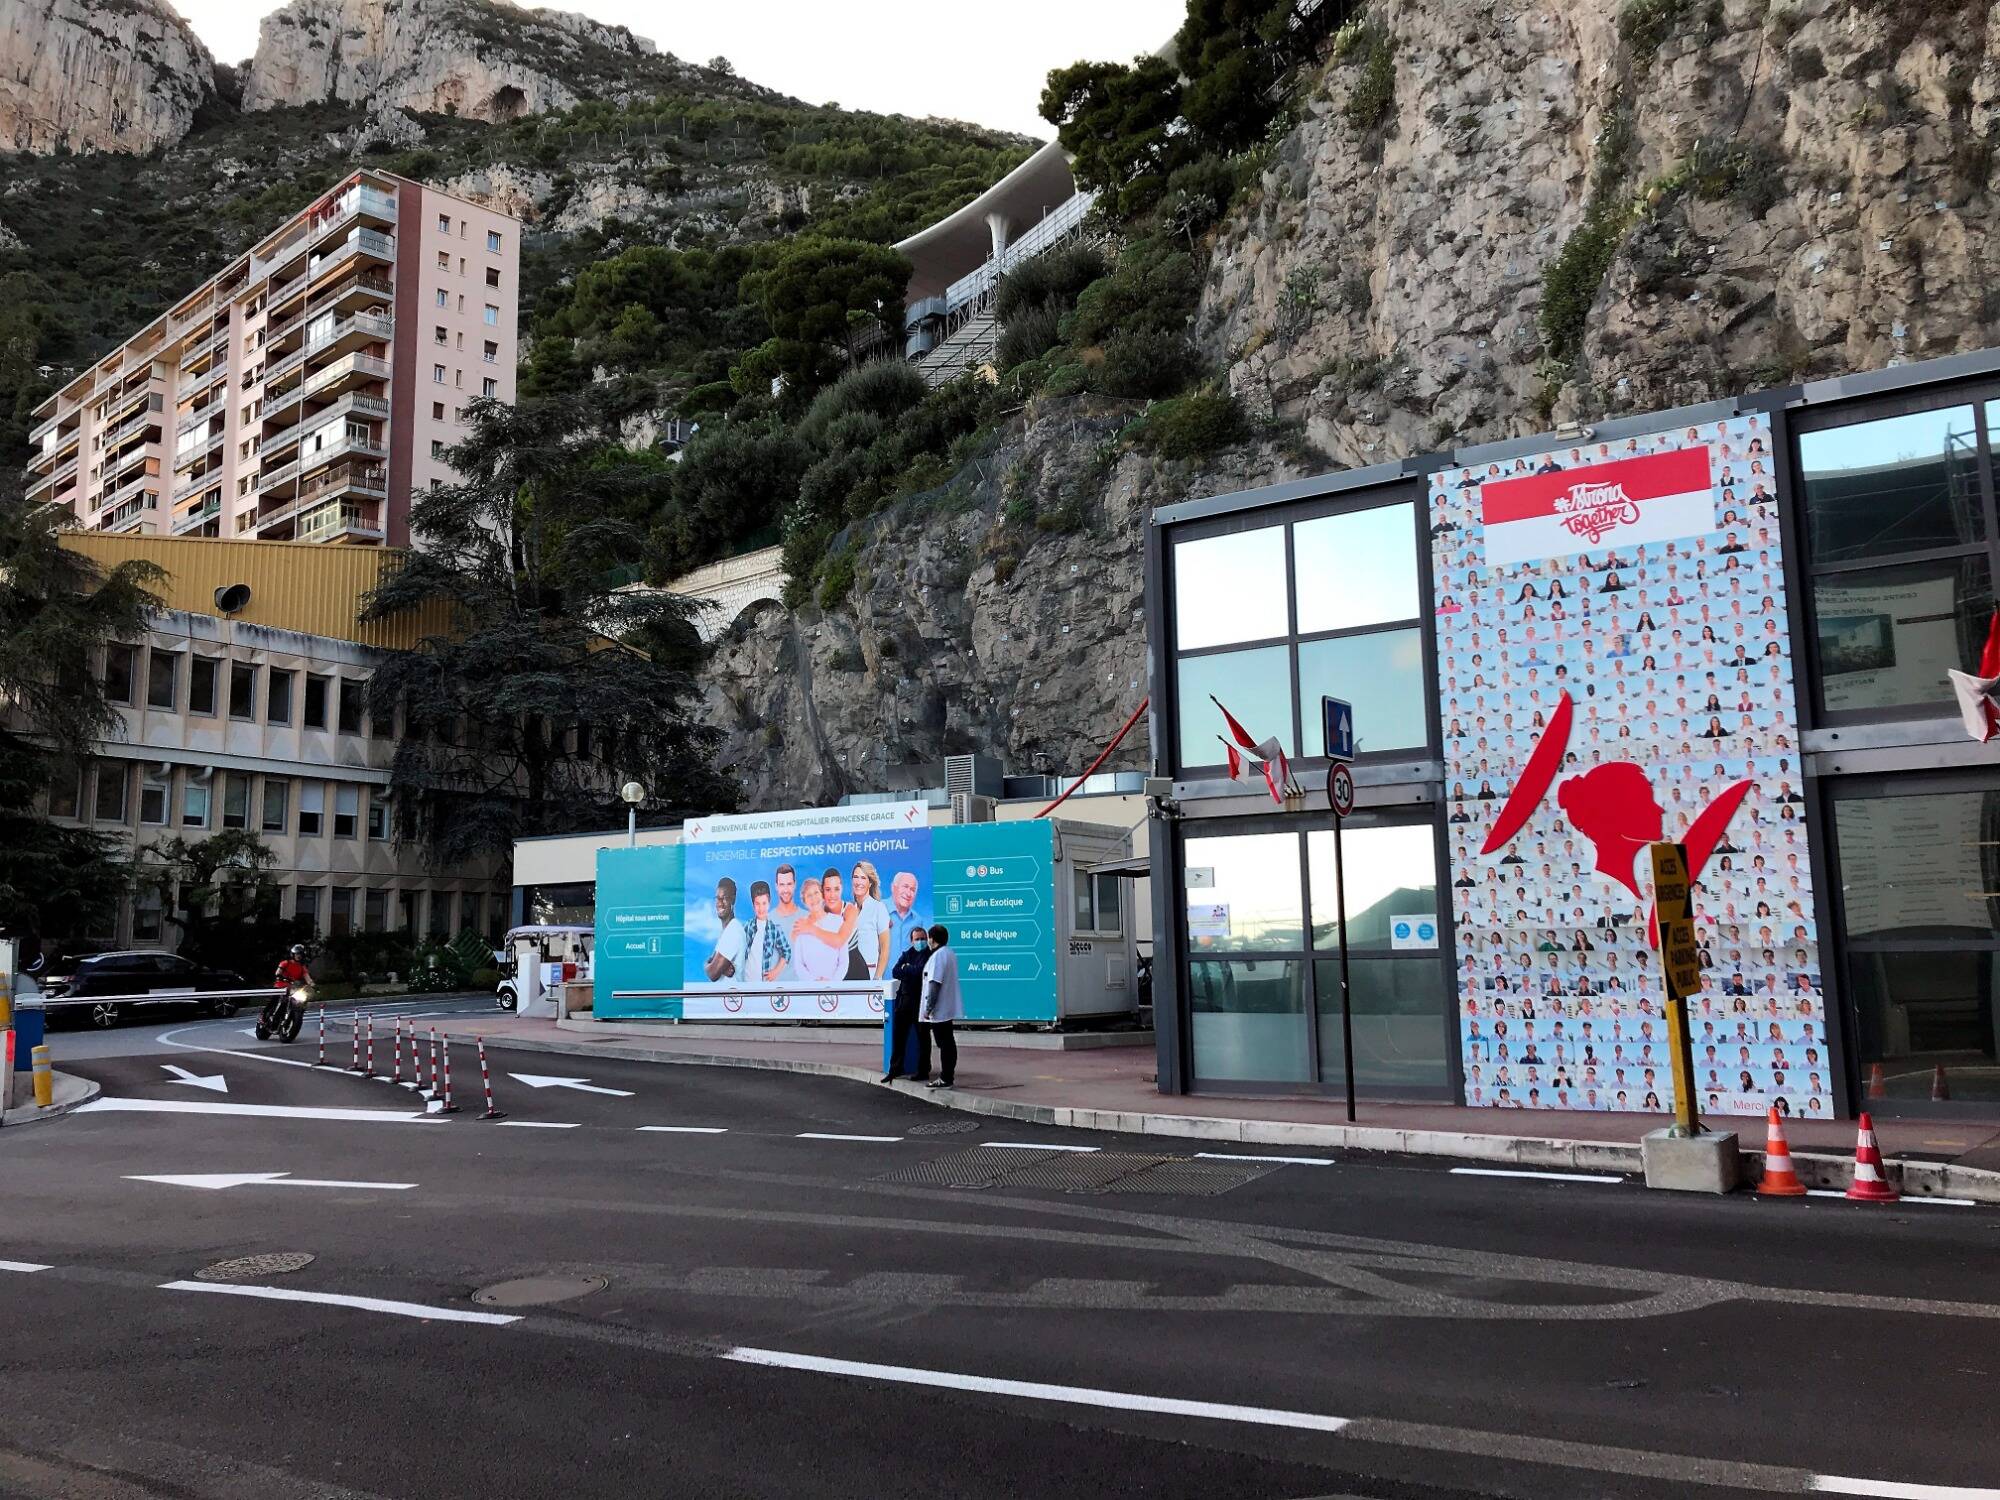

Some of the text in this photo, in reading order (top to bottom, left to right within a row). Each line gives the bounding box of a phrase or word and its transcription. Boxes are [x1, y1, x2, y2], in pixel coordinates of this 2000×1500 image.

[1336, 778, 1349, 802] 30
[711, 812, 895, 833] BIENVENUE AU CENTRE HOSPITALIER PRINCESSE GRACE
[705, 838, 909, 862] ENSEMBLE RESPECTONS NOTRE HÔPITAL
[989, 866, 1004, 875] Bus
[965, 898, 1024, 908] Jardin Exotique
[615, 913, 634, 923] Hôpital
[960, 930, 1017, 940] Bd de Belgique
[982, 963, 1011, 971] Pasteur
